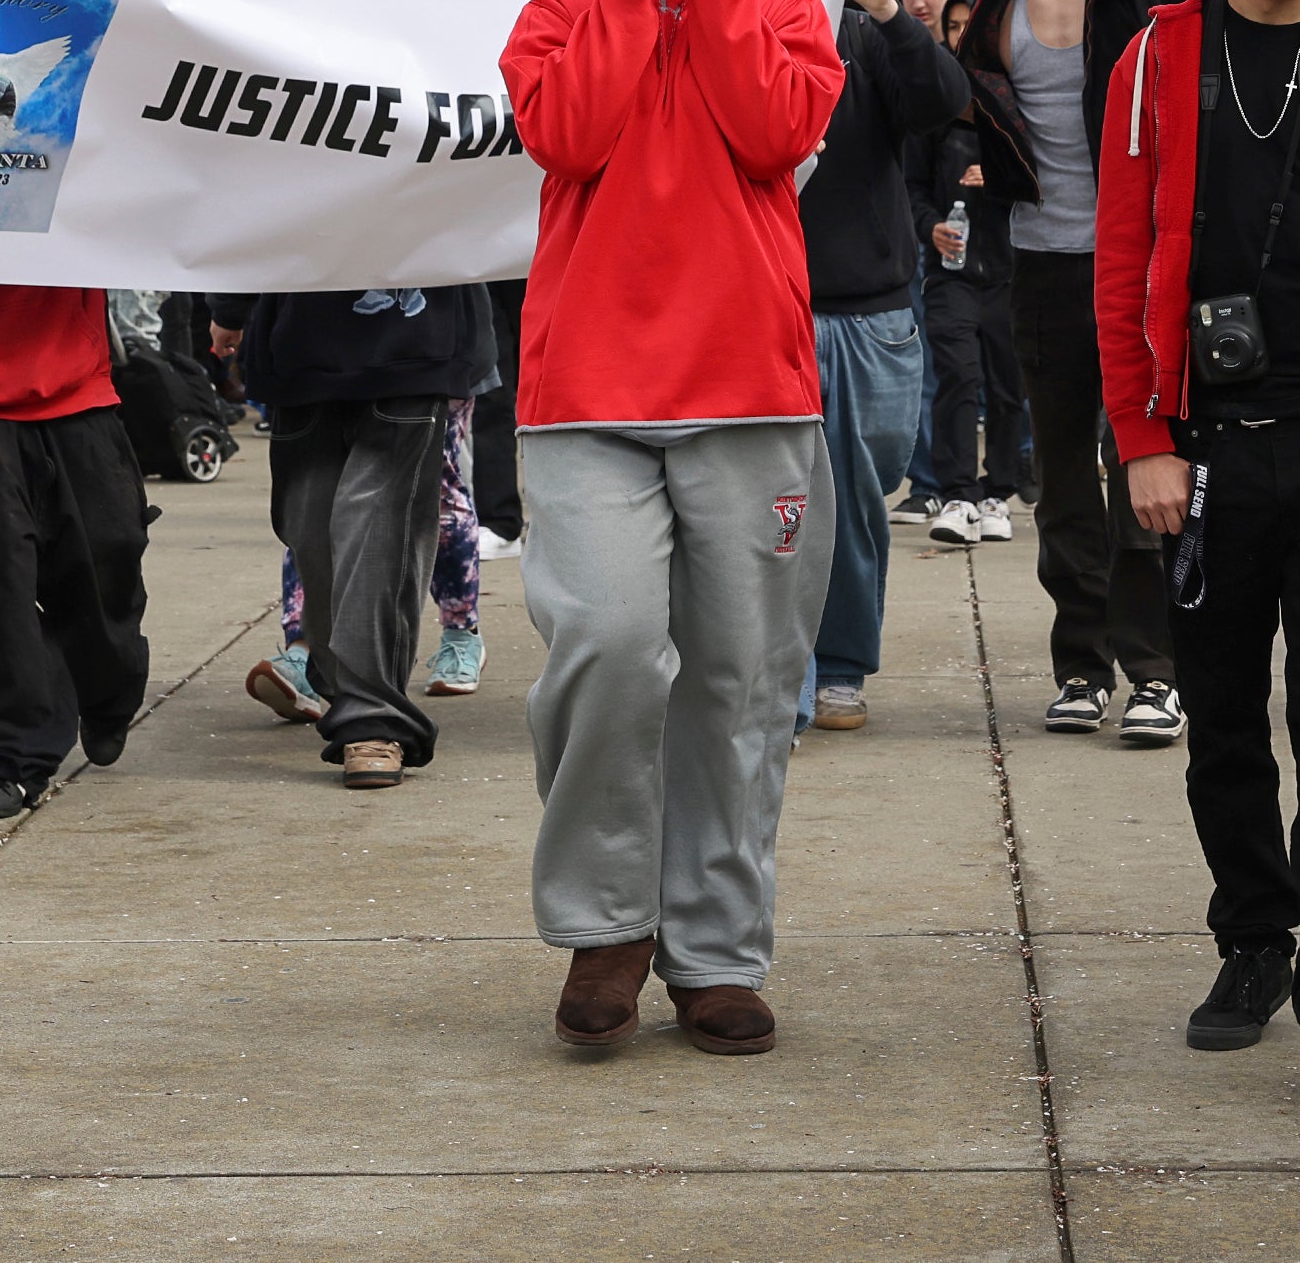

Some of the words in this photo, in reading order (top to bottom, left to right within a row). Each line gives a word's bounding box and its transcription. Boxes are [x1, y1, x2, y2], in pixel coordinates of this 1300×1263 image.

[141, 60, 402, 158] JUSTICE
[1196, 464, 1208, 489] FULL
[1190, 489, 1205, 518] SEND
